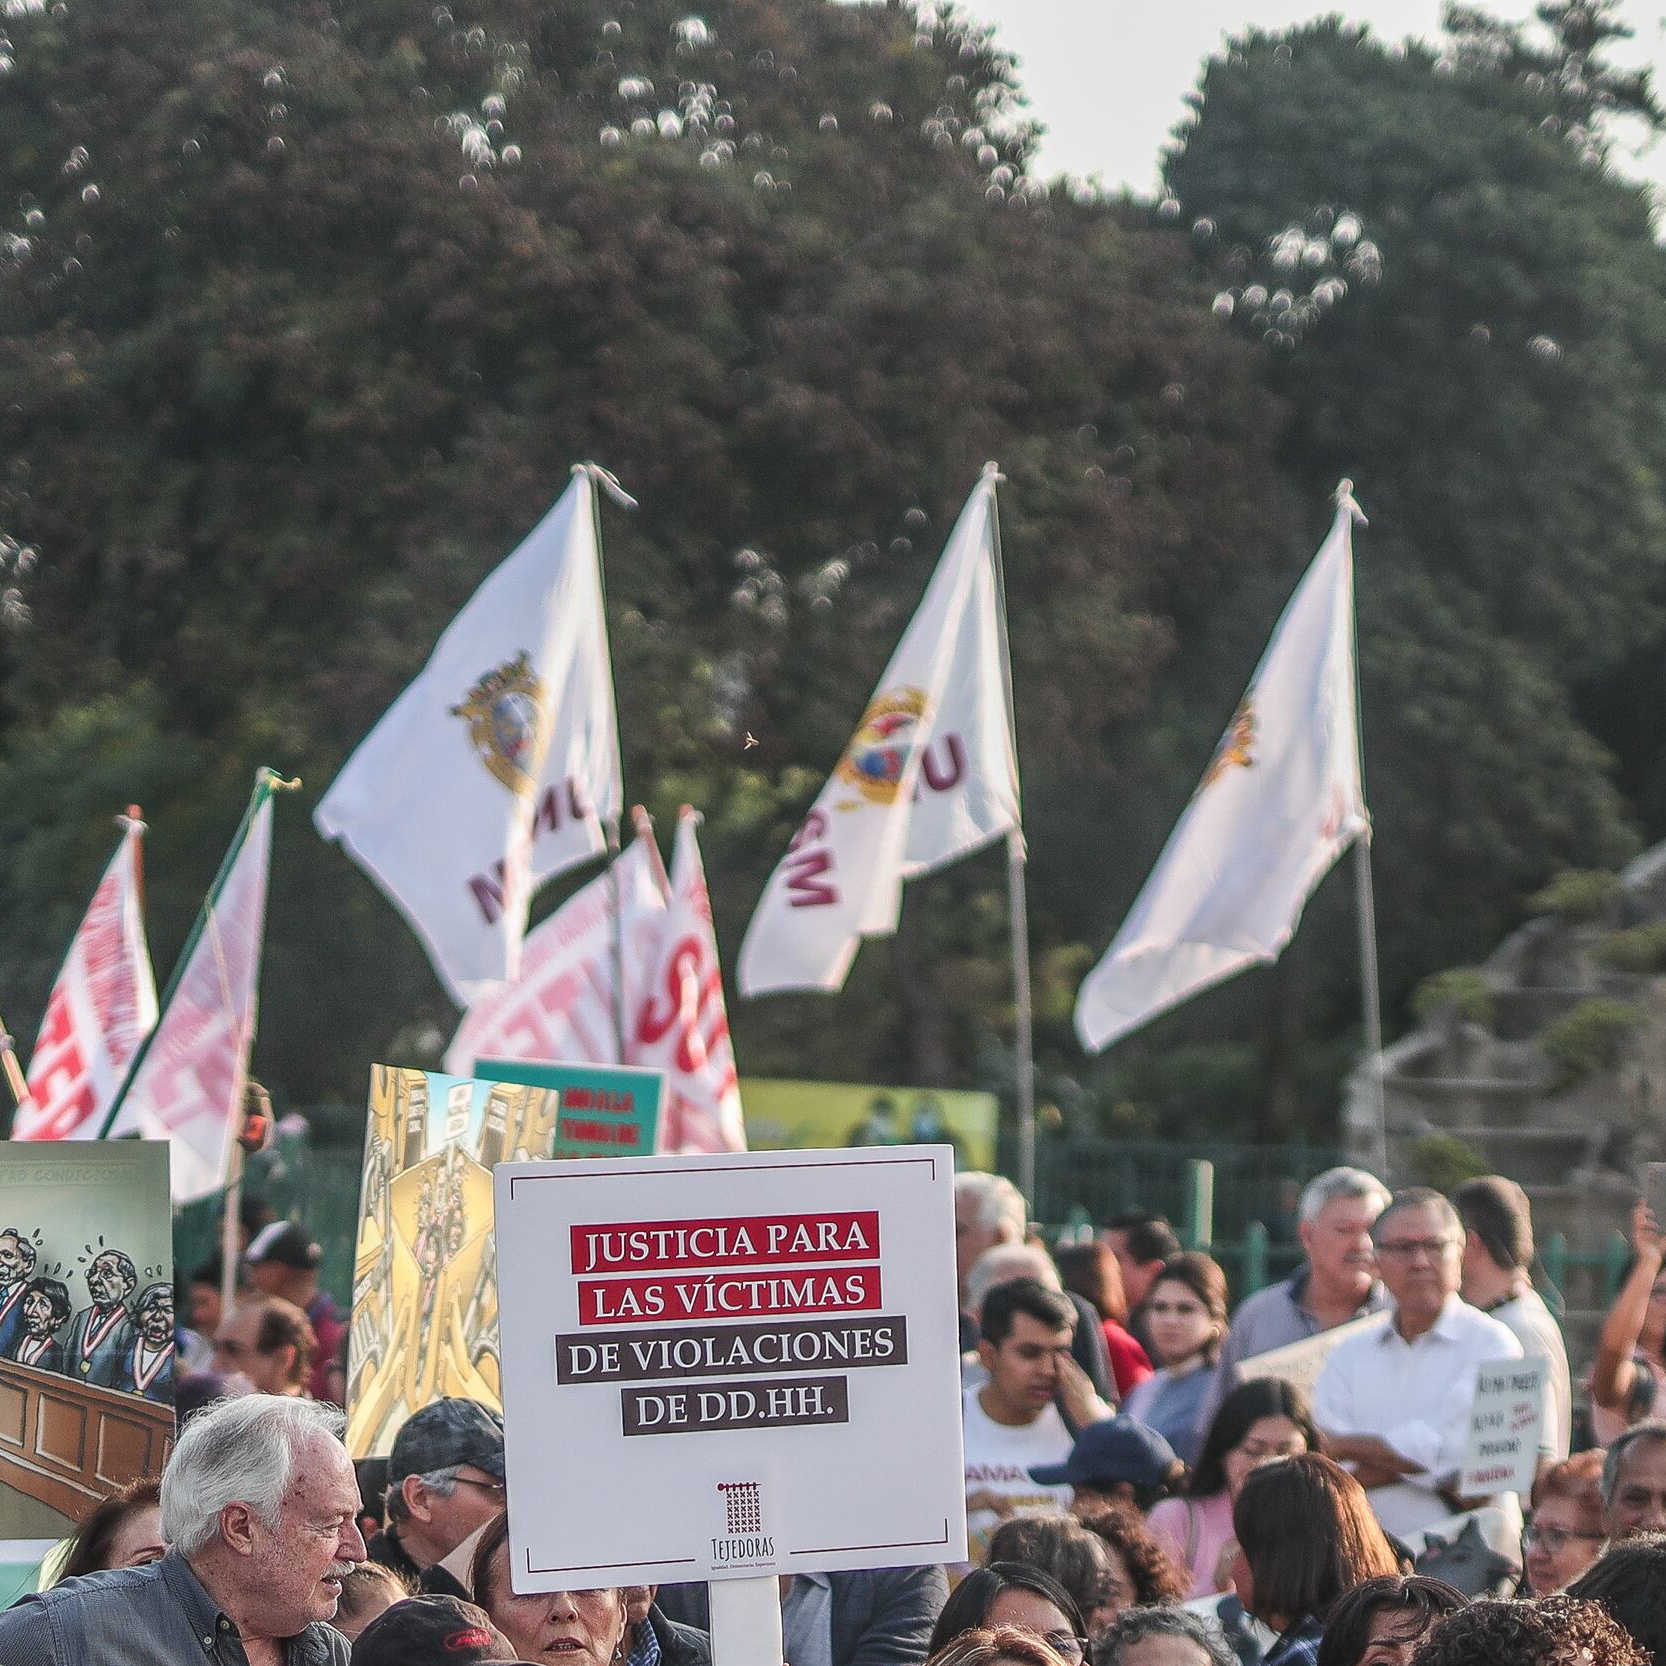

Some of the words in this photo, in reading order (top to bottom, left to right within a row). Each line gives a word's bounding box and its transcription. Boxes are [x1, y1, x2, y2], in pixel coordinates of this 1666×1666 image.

[584, 1226, 758, 1272] JUSTICIA
[766, 1220, 870, 1255] PARA
[592, 1284, 666, 1319] LAS
[674, 1275, 867, 1314] VÍCTIMAS
[567, 1343, 621, 1376] DE
[629, 1327, 896, 1372] VIOLACIONES
[635, 1393, 689, 1427] DE
[697, 1385, 835, 1424] DD.HH.
